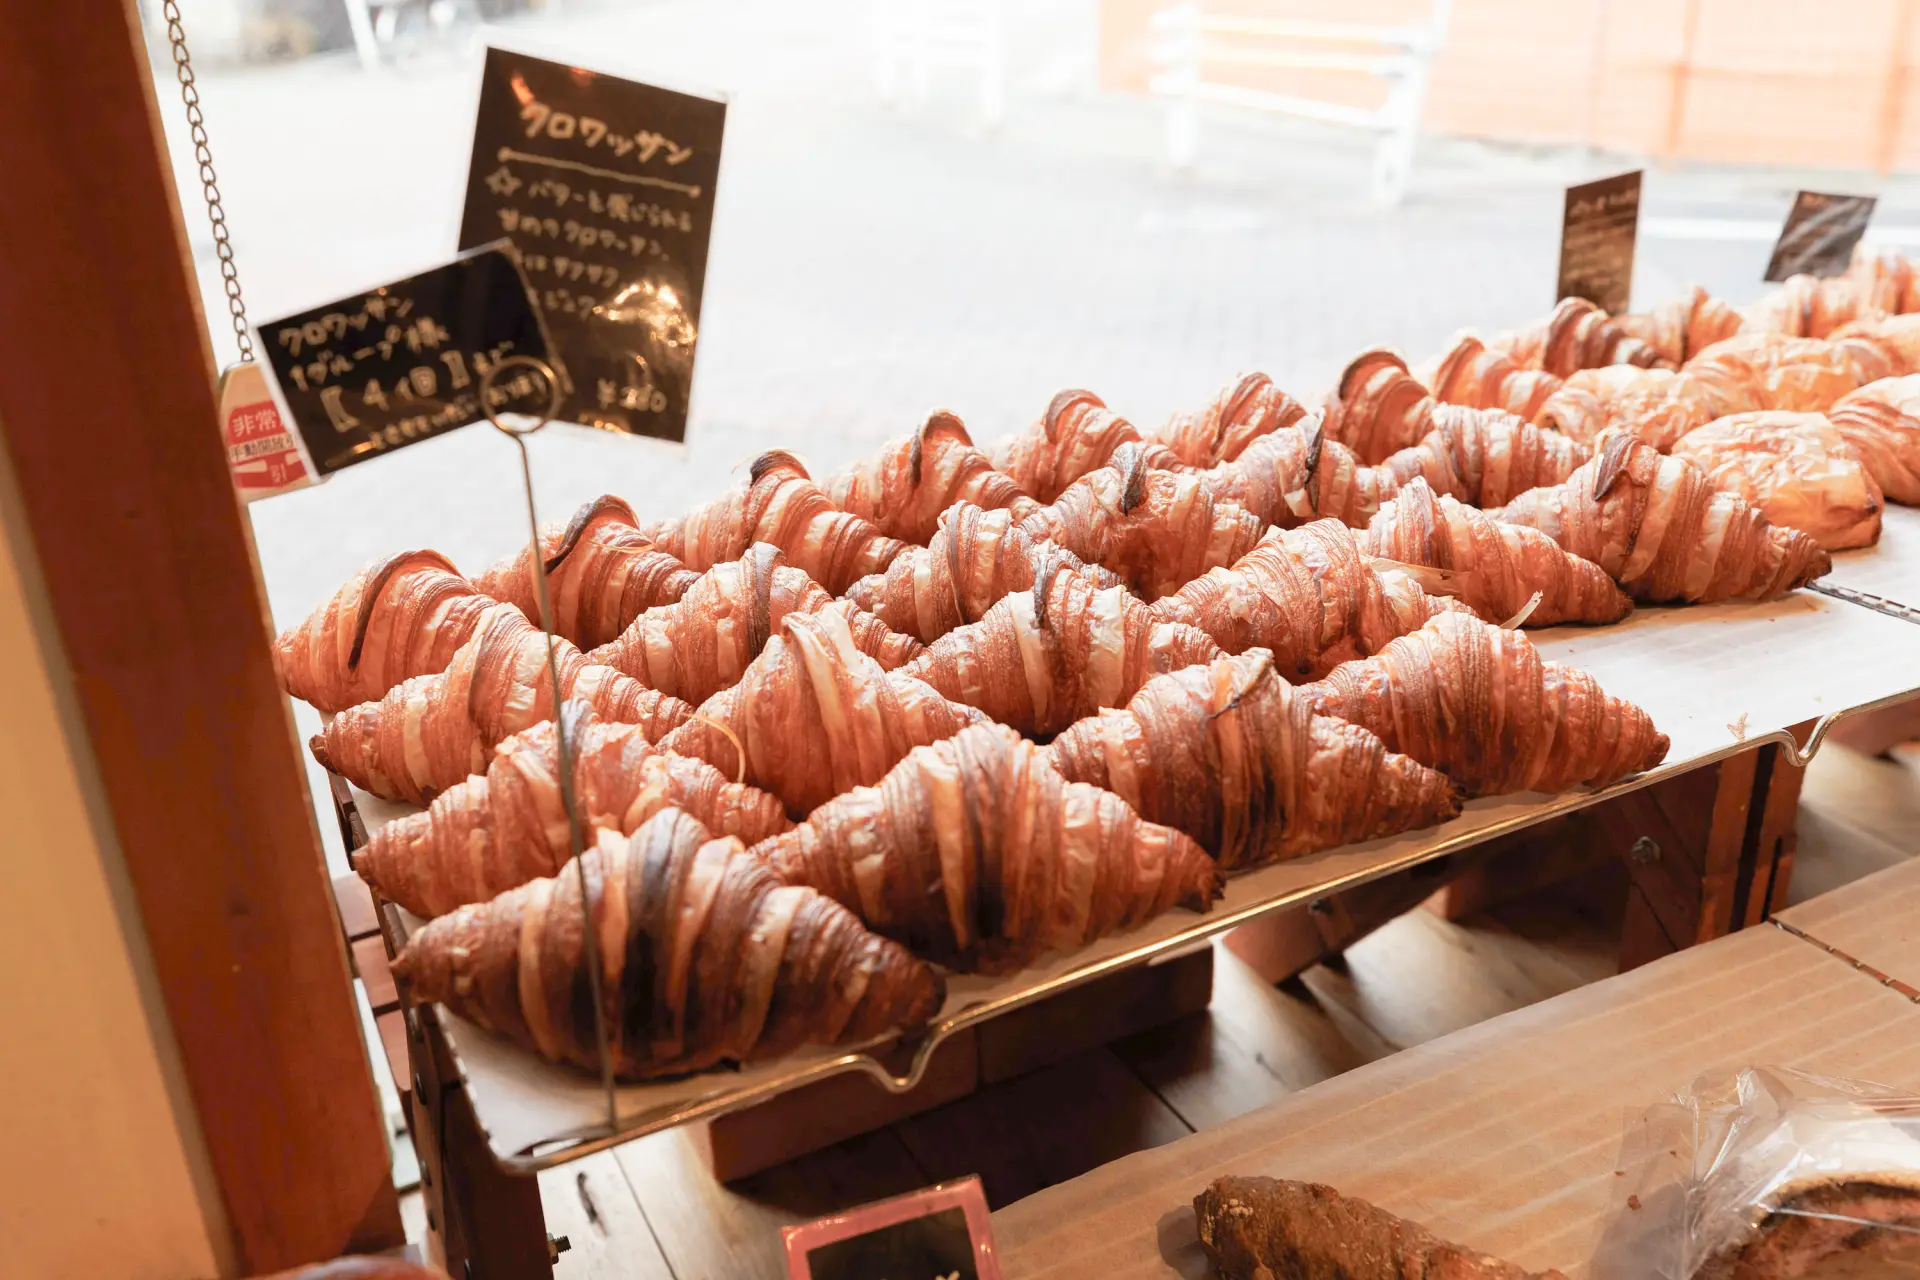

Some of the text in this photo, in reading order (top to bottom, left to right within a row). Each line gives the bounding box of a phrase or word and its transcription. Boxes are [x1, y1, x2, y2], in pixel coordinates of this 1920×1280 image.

[519, 102, 693, 166] クロワッサン
[278, 296, 414, 356] クロワッサン
[231, 408, 284, 438] 非常
